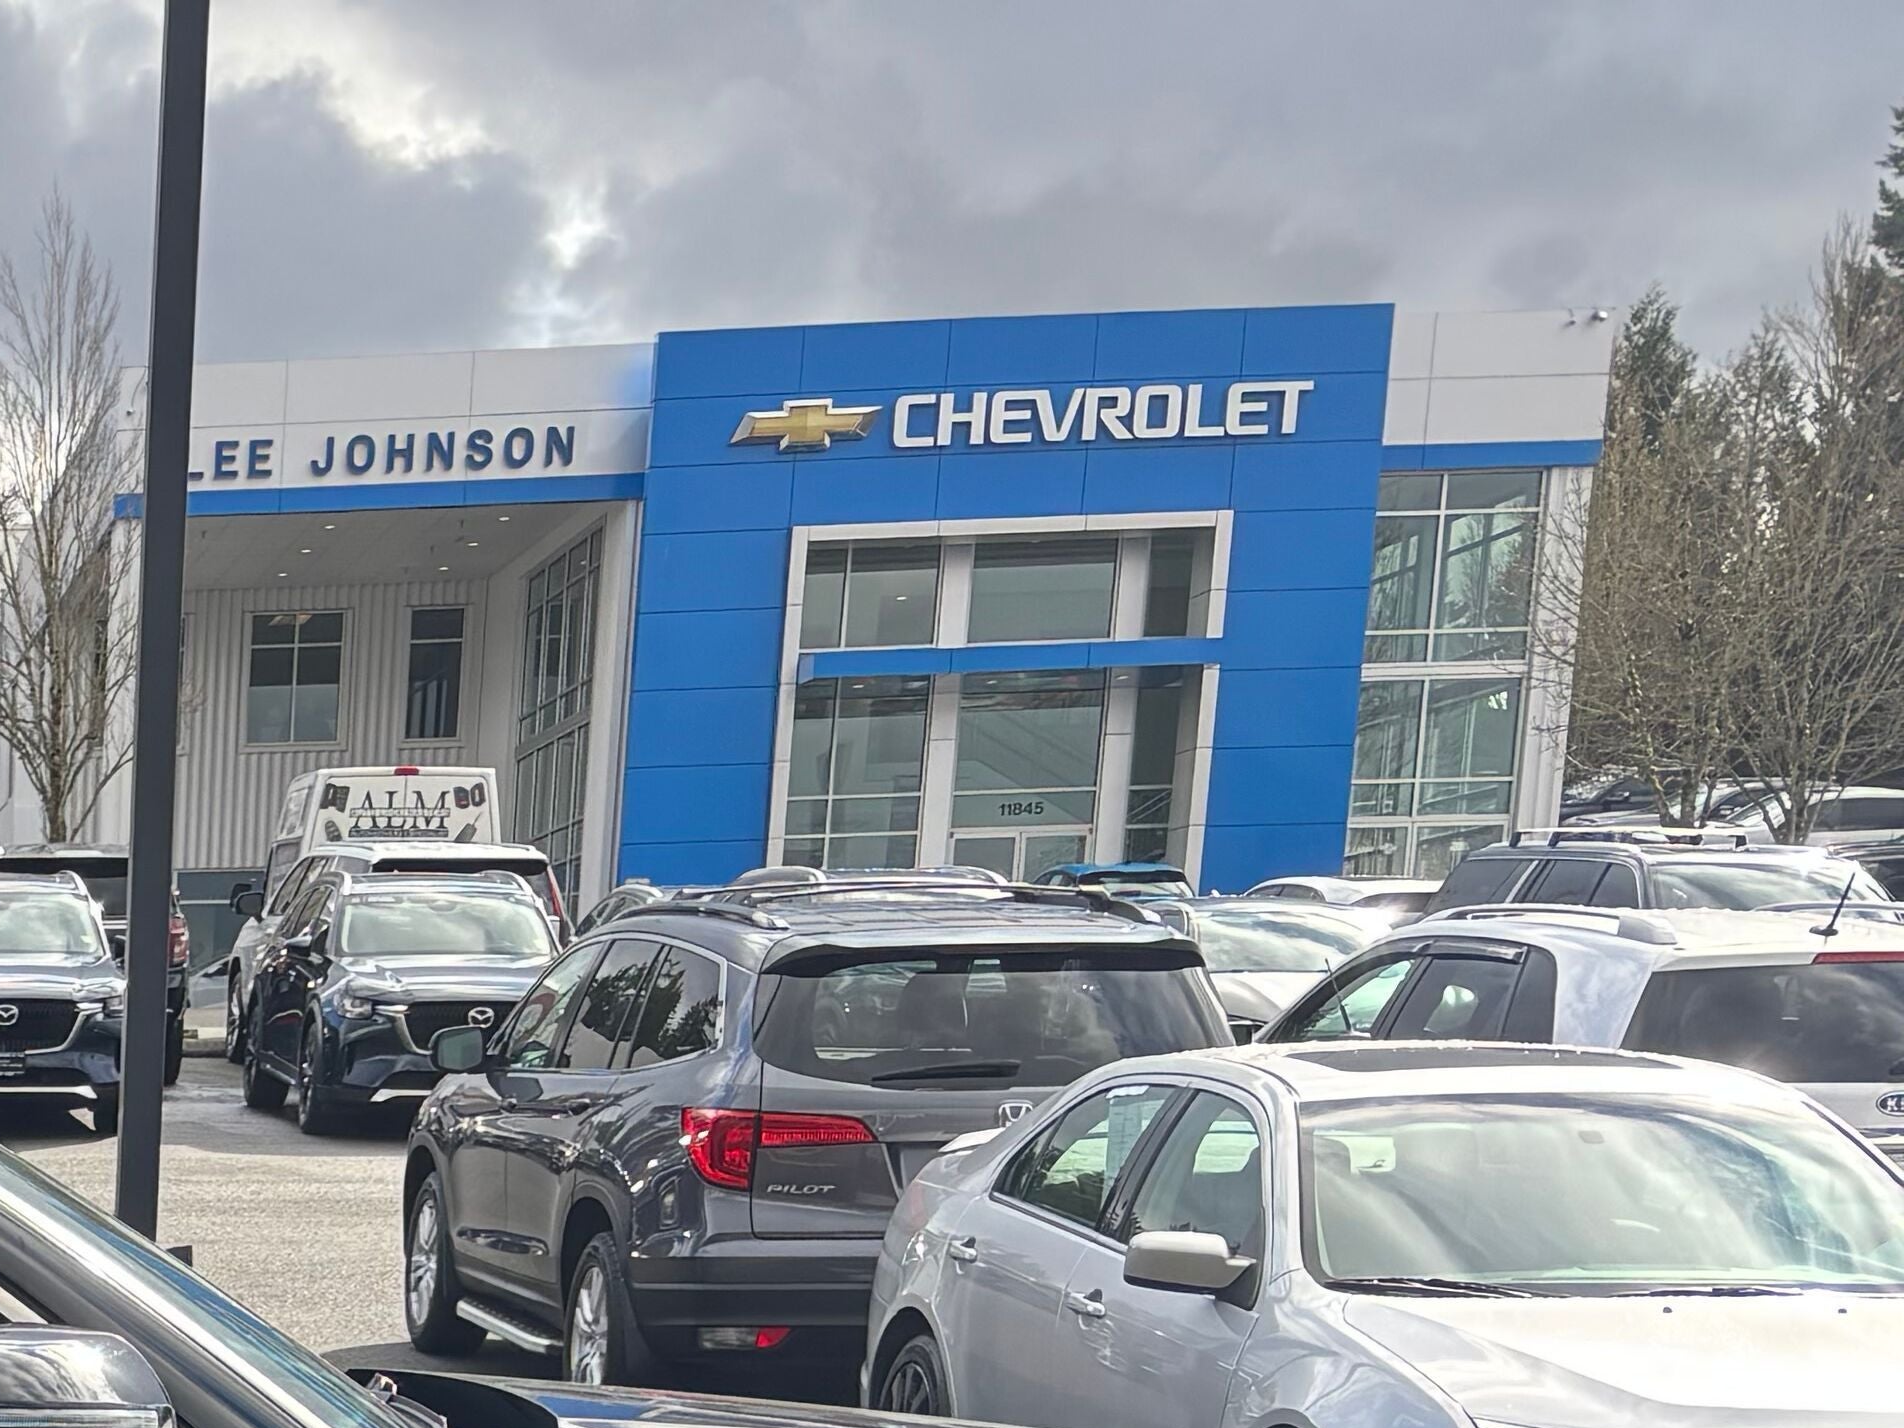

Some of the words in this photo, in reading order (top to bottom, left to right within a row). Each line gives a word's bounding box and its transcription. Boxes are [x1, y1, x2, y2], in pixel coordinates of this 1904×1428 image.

[893, 380, 1315, 448] CHEVROLET
[310, 426, 576, 477] JOHNSON
[350, 789, 450, 829] ALM
[998, 801, 1044, 817] 11845
[766, 1184, 836, 1194] PILOT
